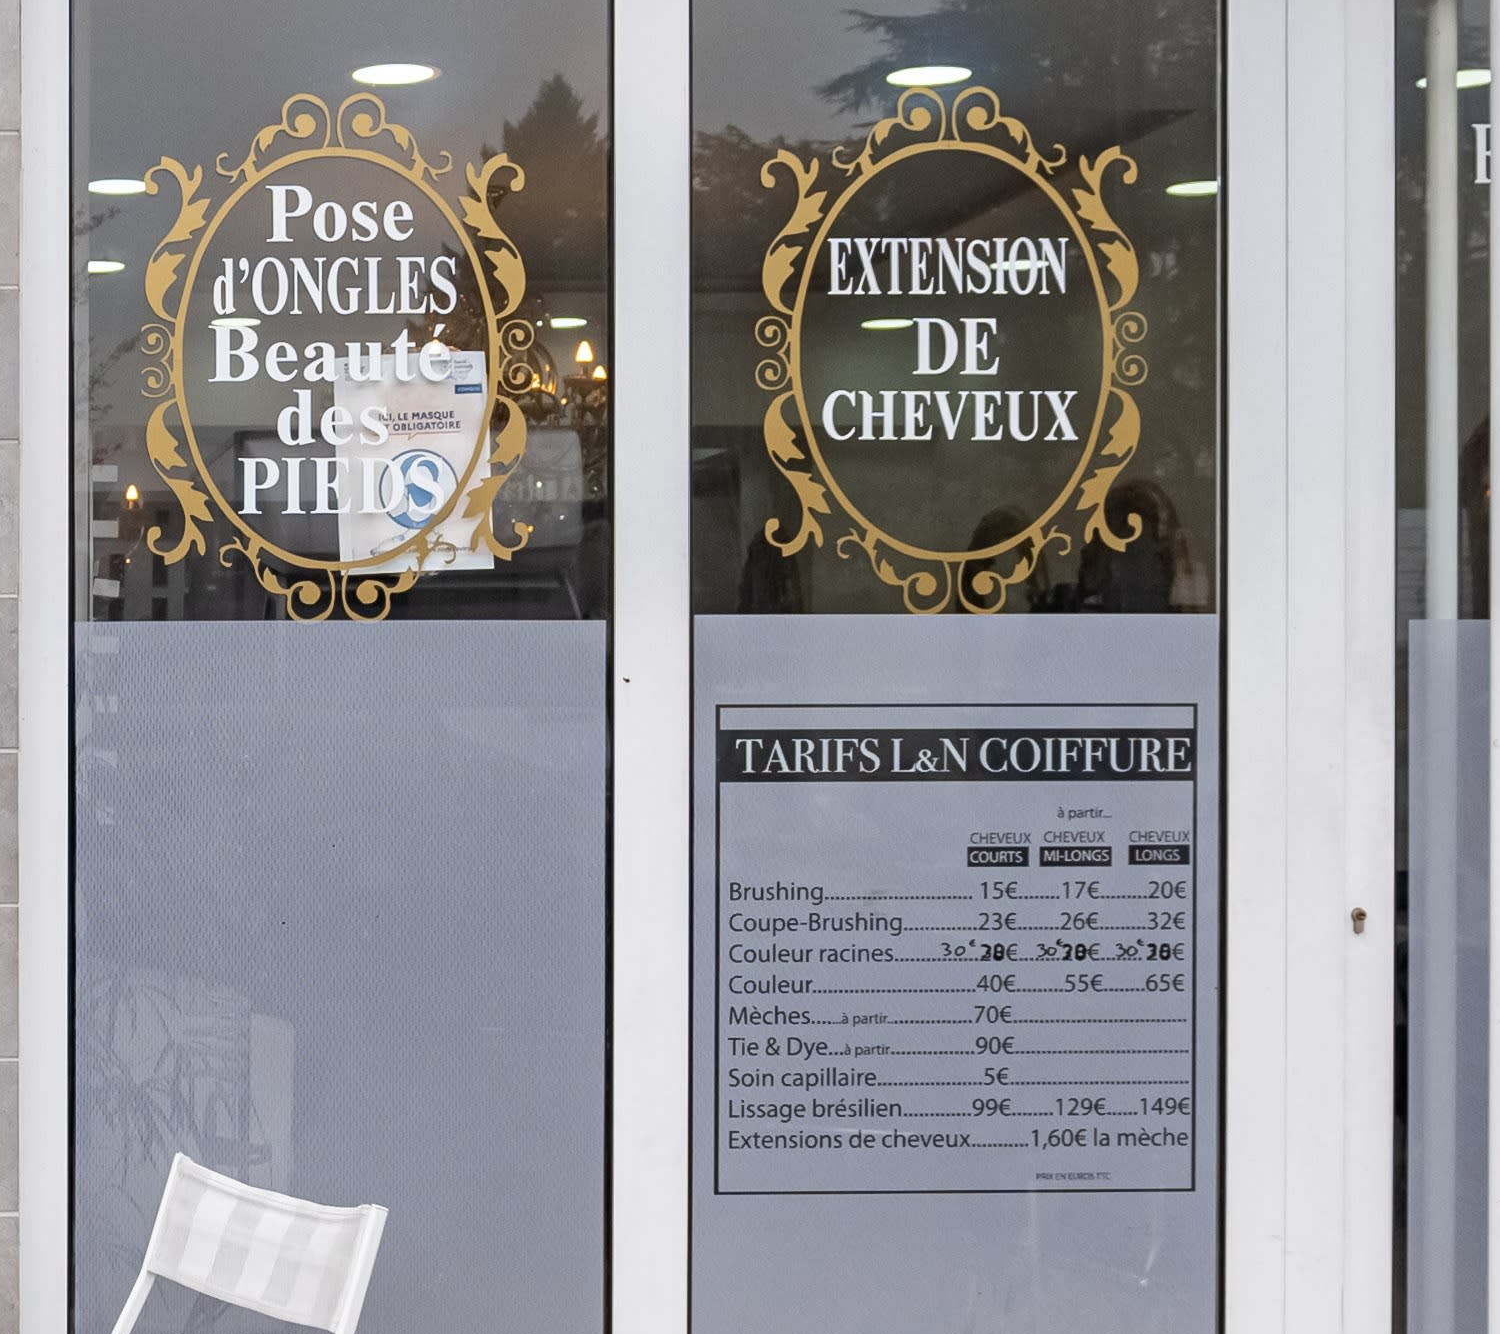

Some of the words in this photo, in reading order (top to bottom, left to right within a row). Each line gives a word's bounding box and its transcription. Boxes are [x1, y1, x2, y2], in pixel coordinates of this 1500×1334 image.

[265, 184, 414, 243] Pose
[828, 237, 1069, 295] EXTENSION
[208, 323, 453, 383] Beauté
[912, 317, 1000, 375] DE
[277, 389, 389, 447] des
[393, 421, 461, 431] OBLIGATOIRE
[398, 413, 408, 421] LE
[412, 411, 455, 421] MASQUE
[821, 390, 1078, 441] CHEVEUX
[237, 456, 444, 515] PIEDS
[735, 738, 881, 774] TARIFS
[891, 737, 969, 774] L&N
[978, 736, 1193, 774] COIFFURE
[1057, 806, 1065, 818] à
[969, 831, 1031, 845] CHEVEUX
[1043, 830, 1105, 844] CHEVEUX
[1128, 829, 1190, 843] CHEVEUX
[970, 851, 1023, 864] COURTS
[1043, 850, 1110, 864] MI-LONGS
[1136, 849, 1181, 862] LONGS
[729, 882, 824, 906] Brushing
[979, 881, 1018, 899] 15€
[1062, 881, 1100, 899] 17€
[1147, 881, 1186, 899] 20€
[729, 913, 903, 937] Coupe-Brushing
[978, 912, 1017, 930] 23€
[1060, 912, 1099, 930] 26€
[1147, 912, 1186, 930] 32€
[728, 943, 816, 963] Couleur
[820, 943, 895, 963] racines
[728, 975, 813, 995] Couleur
[976, 975, 1017, 993] 40€
[1064, 974, 1104, 992] 55€
[1145, 974, 1186, 992] 65€
[728, 1005, 811, 1026] Mèches
[974, 1005, 1013, 1024] 70€
[728, 1037, 761, 1057] Tie
[765, 1038, 781, 1057] &
[786, 1038, 828, 1061] Dye
[975, 1036, 1015, 1055] 90€
[728, 1068, 776, 1087] Soin
[781, 1067, 877, 1093] capillaire
[983, 1068, 1009, 1085] 5€
[728, 1099, 805, 1122] Lissage
[812, 1098, 902, 1118] brésilien
[972, 1098, 1011, 1117] 99€
[1055, 1098, 1106, 1116] 129€
[1139, 1097, 1190, 1116] 149€
[728, 1130, 843, 1149] Extensions
[849, 1130, 876, 1149] de
[881, 1130, 971, 1149] cheveux
[1031, 1129, 1087, 1151] 1,60€
[1093, 1128, 1112, 1148] la
[1117, 1128, 1189, 1148] mèche
